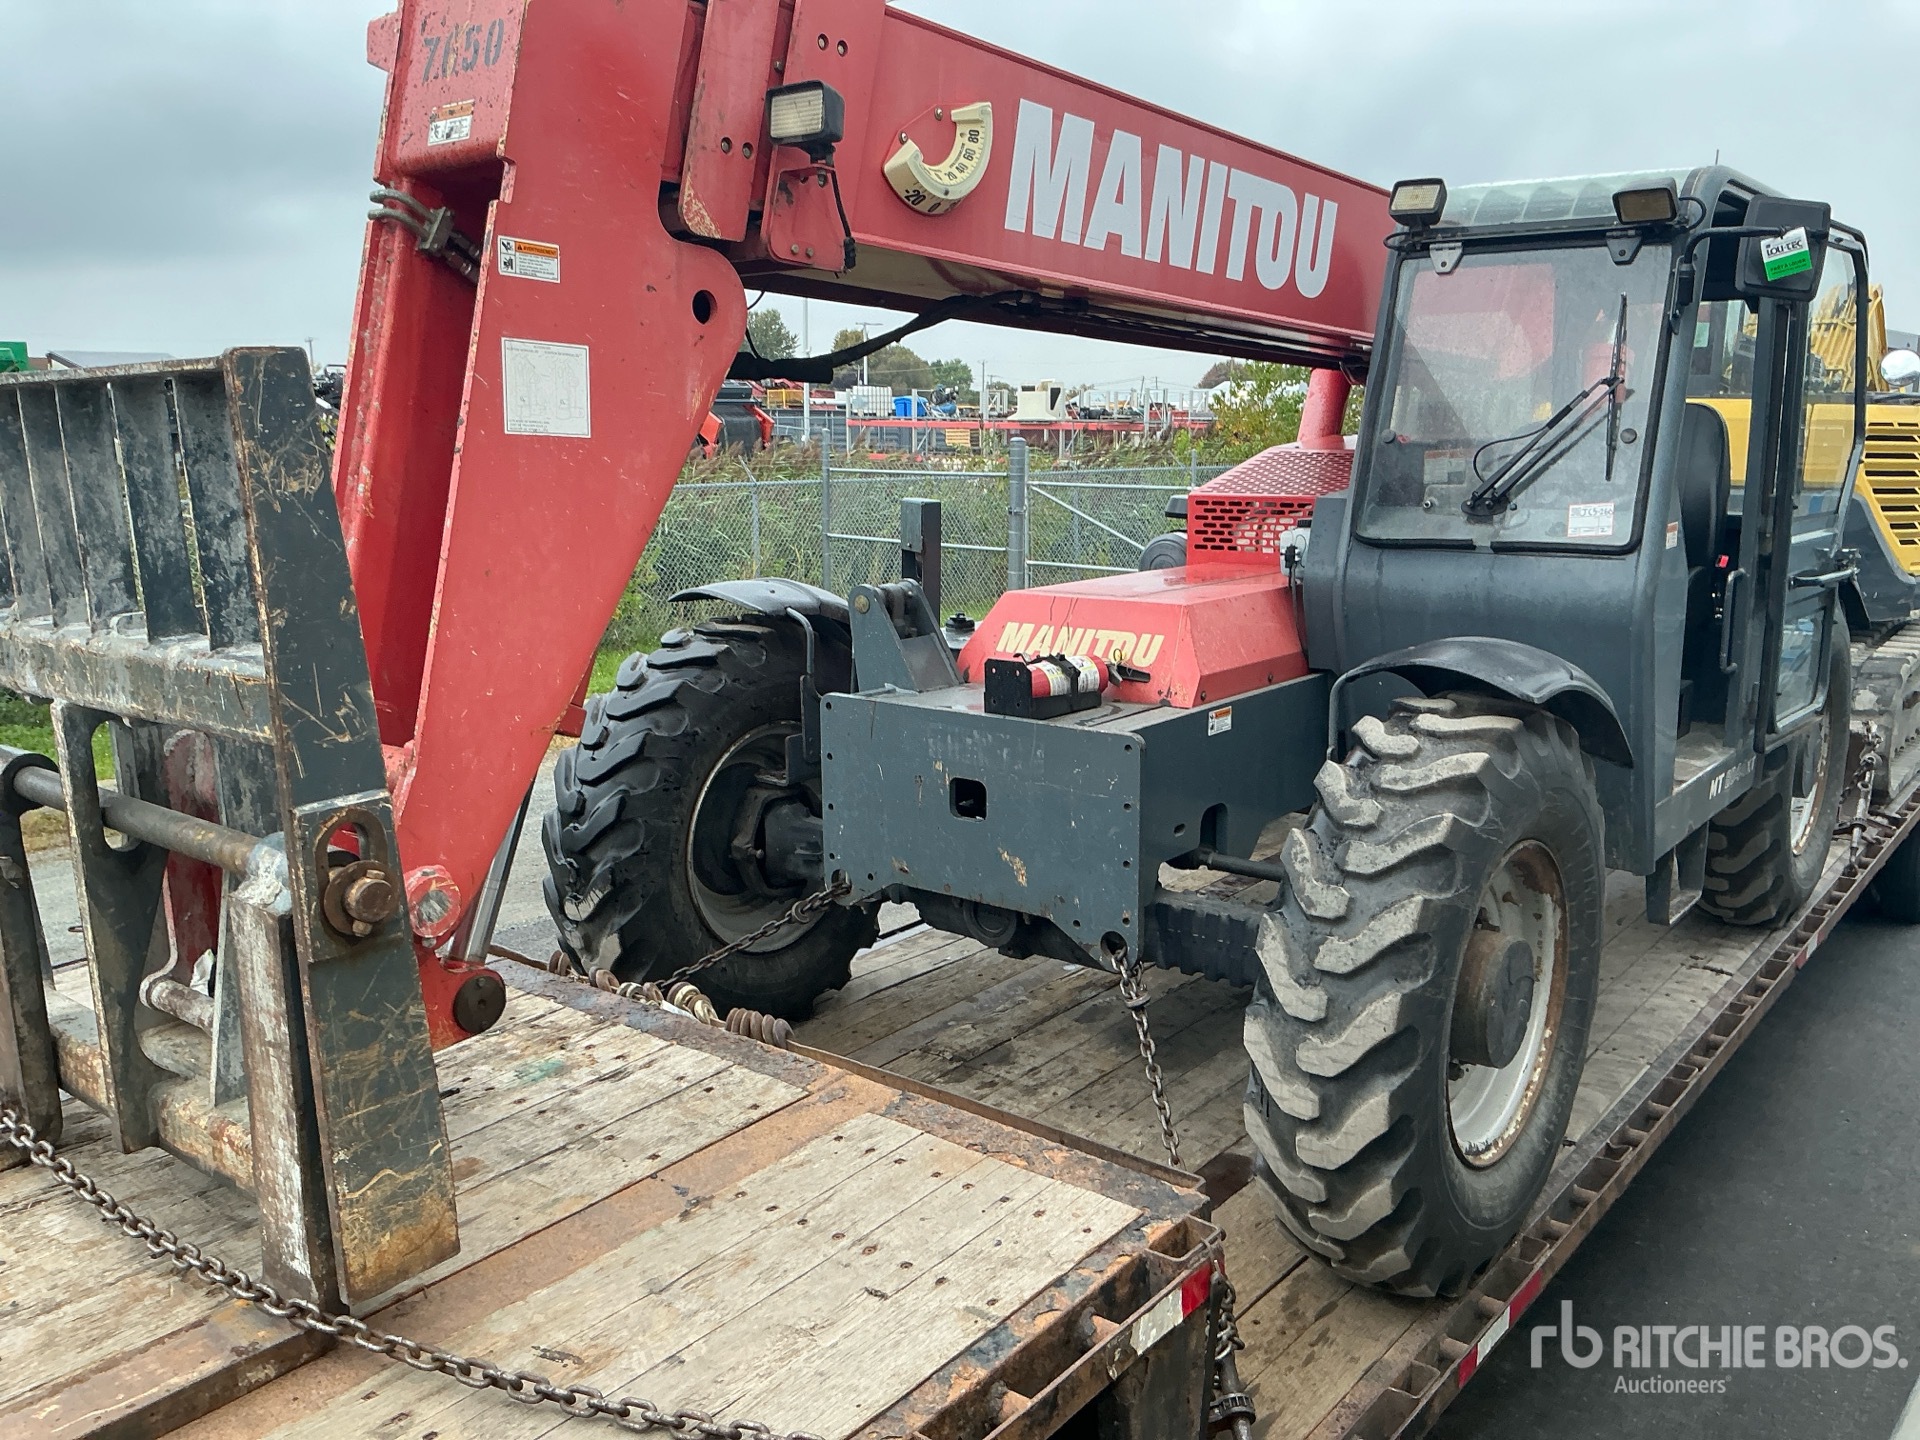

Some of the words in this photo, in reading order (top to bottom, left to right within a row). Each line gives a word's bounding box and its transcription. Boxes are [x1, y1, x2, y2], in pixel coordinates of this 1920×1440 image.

[967, 129, 980, 144] 80
[962, 147, 976, 162] 60
[1004, 98, 1338, 298] MANITOU
[995, 621, 1165, 667] MANITOU
[1709, 772, 1726, 800] MT
